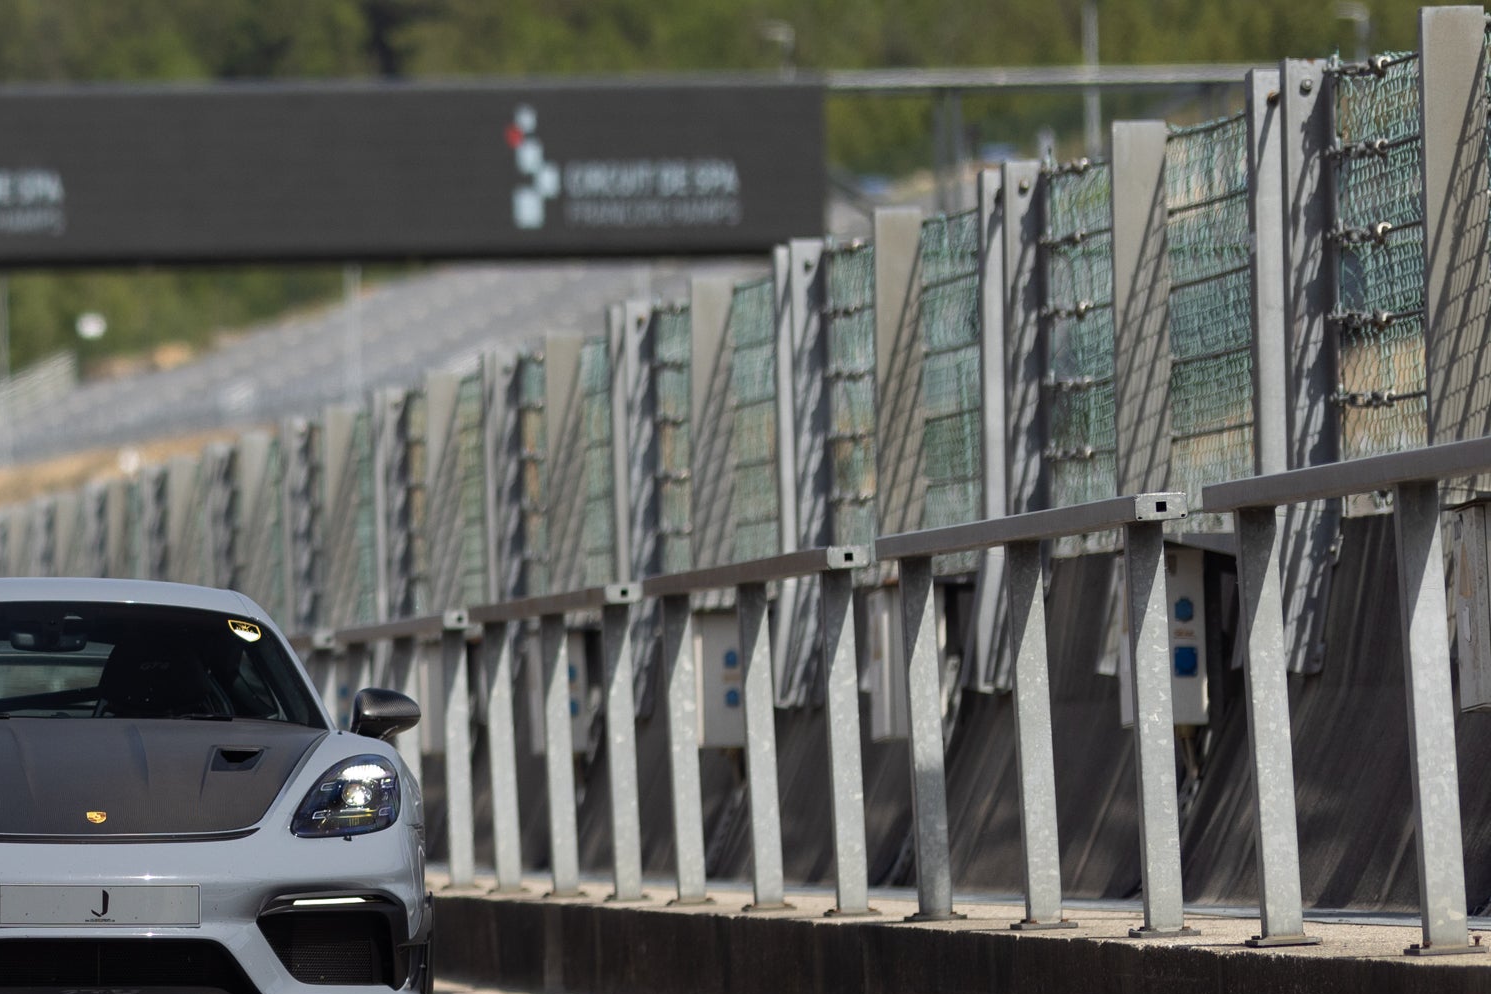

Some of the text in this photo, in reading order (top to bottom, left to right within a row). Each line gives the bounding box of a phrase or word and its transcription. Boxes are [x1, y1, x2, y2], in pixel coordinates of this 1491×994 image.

[18, 170, 64, 206] SPA
[565, 160, 740, 199] CIRCUIT DE SPA
